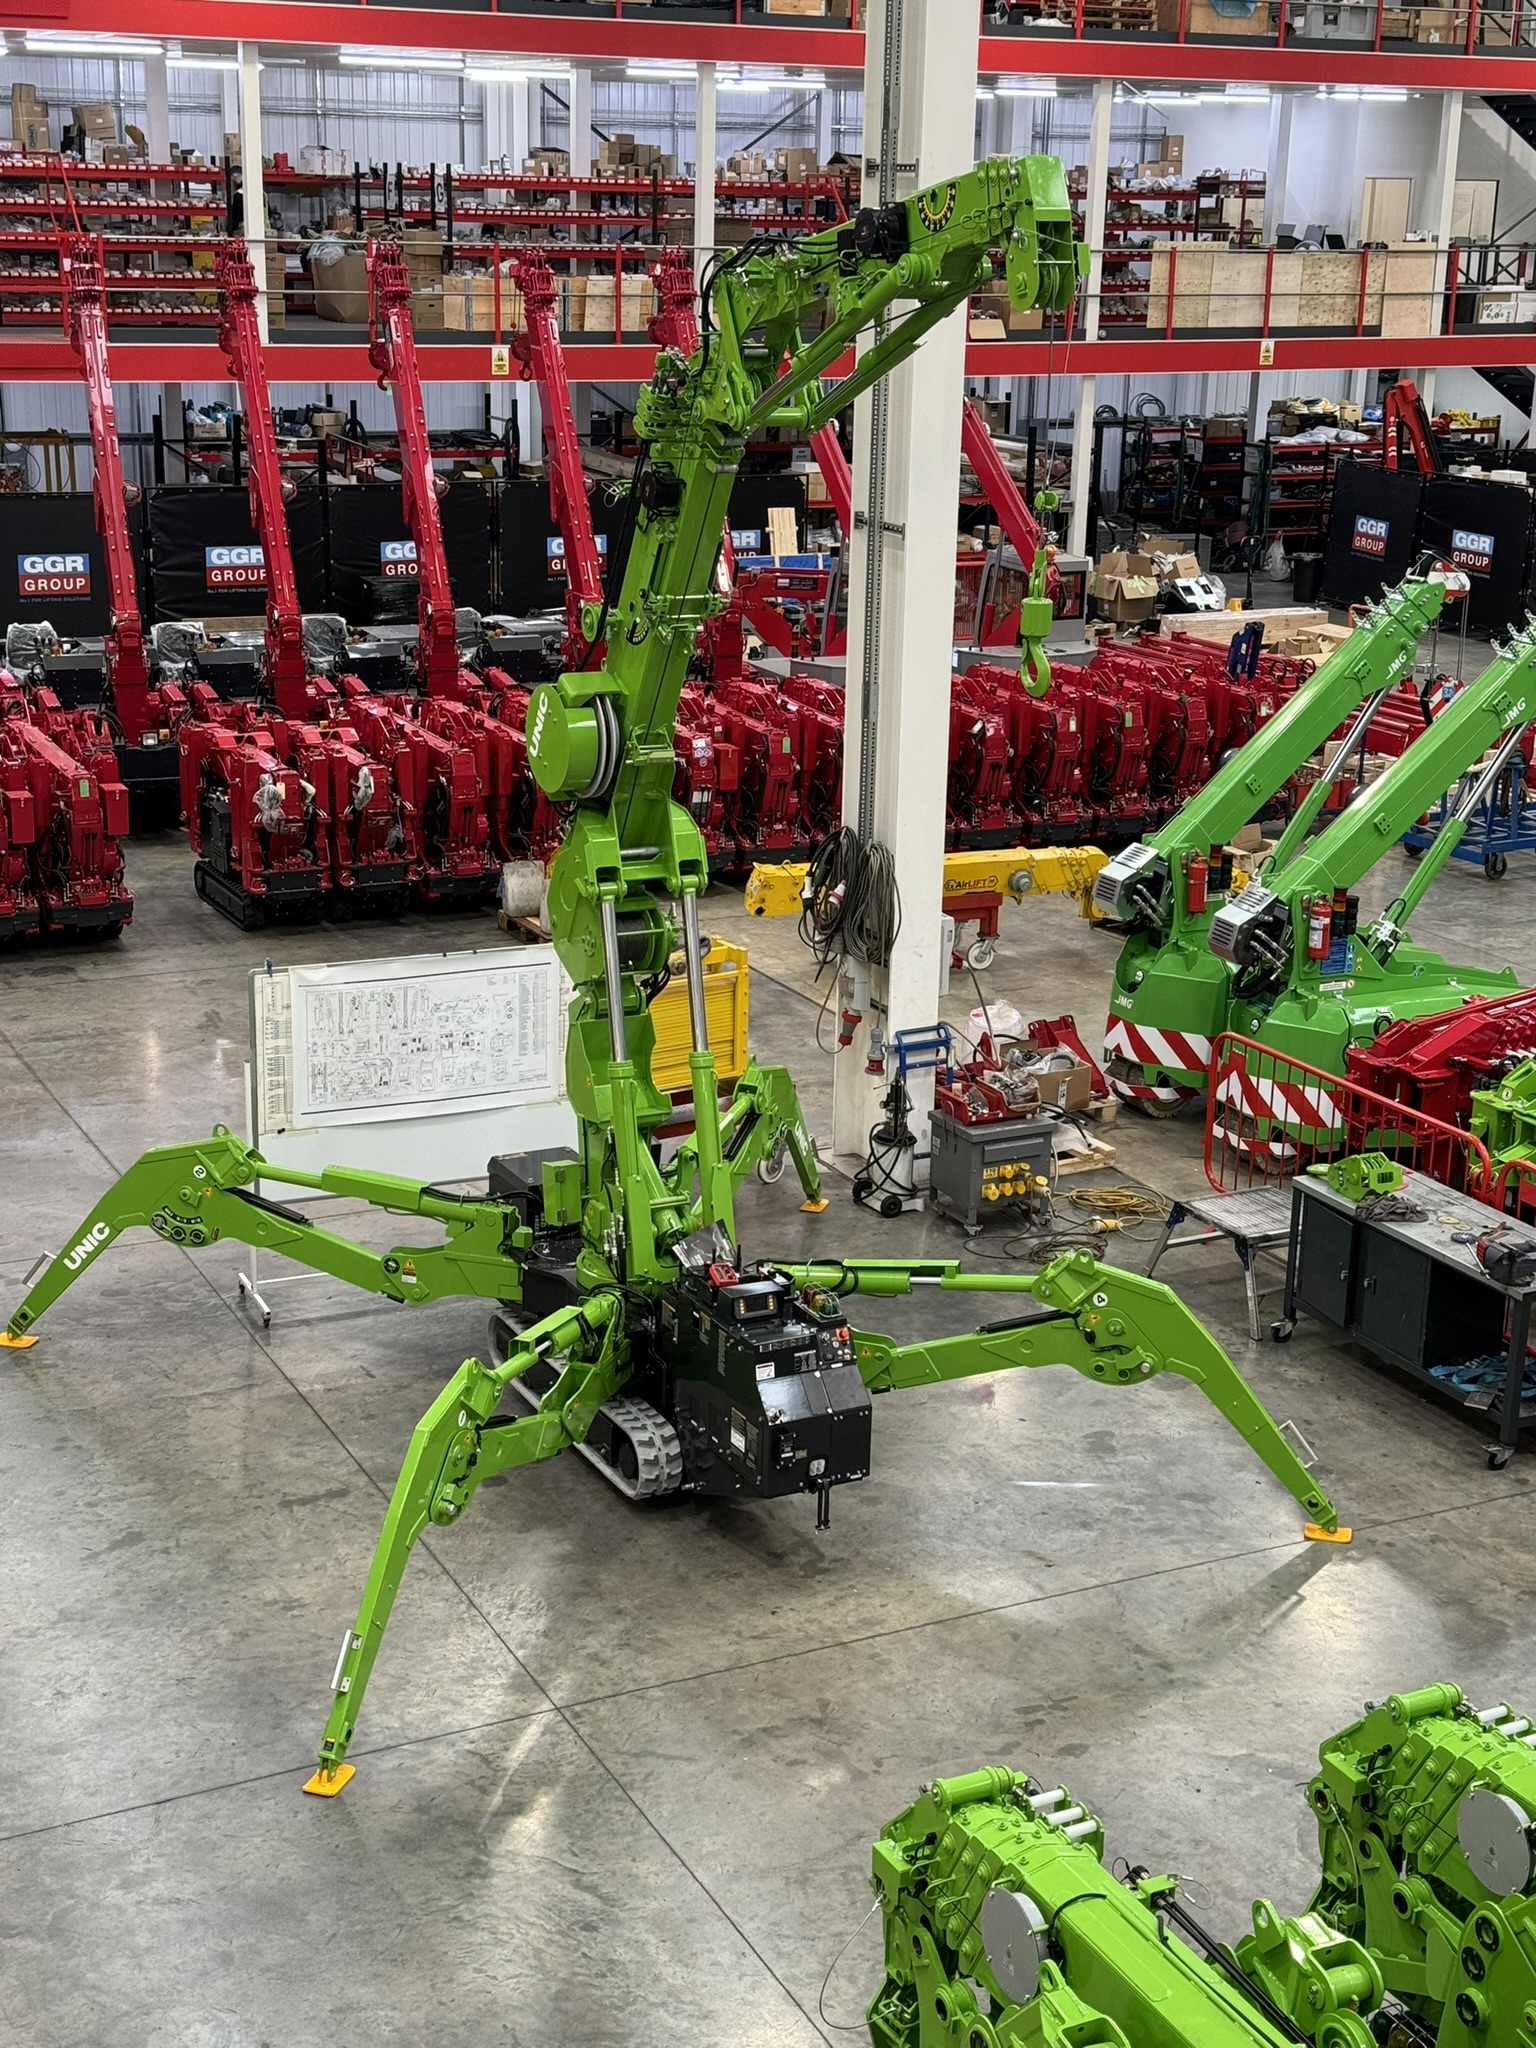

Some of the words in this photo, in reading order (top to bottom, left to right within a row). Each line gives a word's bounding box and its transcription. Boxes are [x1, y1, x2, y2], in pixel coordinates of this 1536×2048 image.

[387, 181, 393, 201] F
[436, 182, 444, 203] G
[1357, 518, 1386, 537] GGR
[731, 532, 756, 546] GR
[1354, 536, 1385, 552] GROUP
[1455, 532, 1491, 552] GGR
[210, 548, 264, 565] GGR
[384, 543, 417, 559] GG
[1453, 551, 1489, 567] GROUP
[23, 556, 84, 574] GGR
[385, 563, 418, 576] GRO
[211, 569, 266, 582] GROUP
[24, 578, 86, 591] GROUP
[1386, 650, 1407, 679] JMG
[1502, 697, 1526, 728] JMG
[529, 692, 549, 757] UNIC
[1113, 994, 1134, 1009] JMG
[195, 1167, 205, 1177] 2
[63, 1221, 111, 1271] UNIC
[1097, 1294, 1106, 1304] 4
